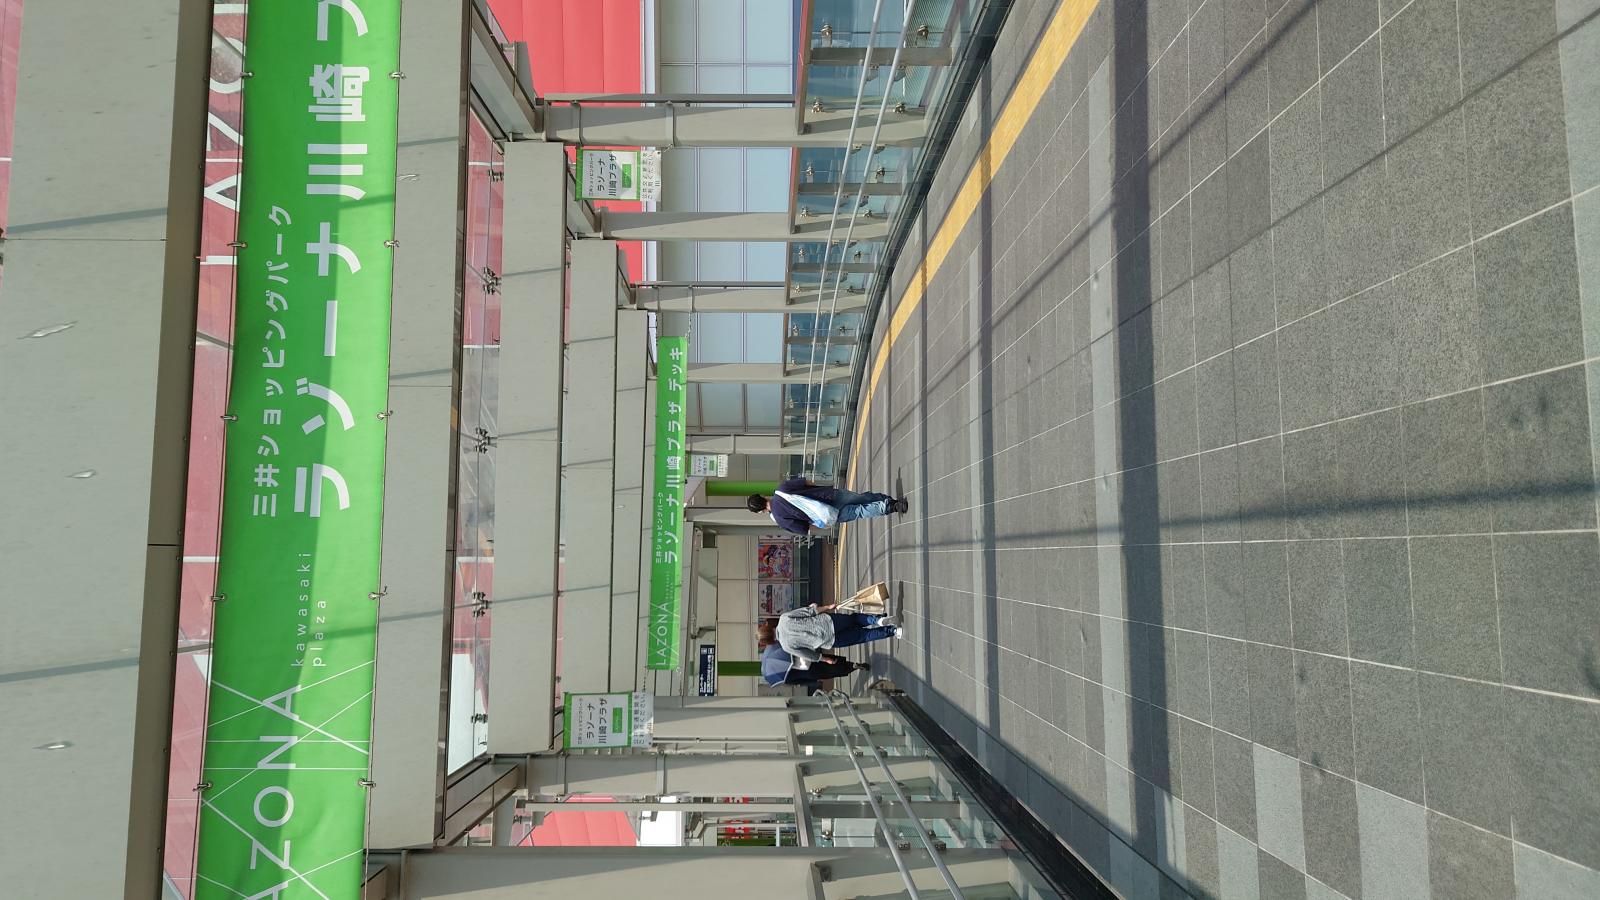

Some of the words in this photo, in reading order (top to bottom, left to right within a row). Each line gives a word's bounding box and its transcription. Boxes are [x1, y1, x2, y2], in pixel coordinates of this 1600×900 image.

[200, 0, 249, 265] AZO
[597, 158, 606, 192] ラゾーナ
[608, 153, 617, 196] 川崎プラザ
[252, 205, 292, 517] 三井ショッピングパーク
[668, 347, 684, 392] デッキ
[664, 400, 682, 564] ラゾーナ川崎プラザ
[656, 492, 664, 564] 三井ショッピングパーク
[291, 553, 312, 667] kawasaki
[309, 600, 327, 667] plaza
[656, 602, 669, 666] LAZONA
[586, 703, 595, 739] ラゾーナ
[598, 698, 607, 744] 川崎プラザ
